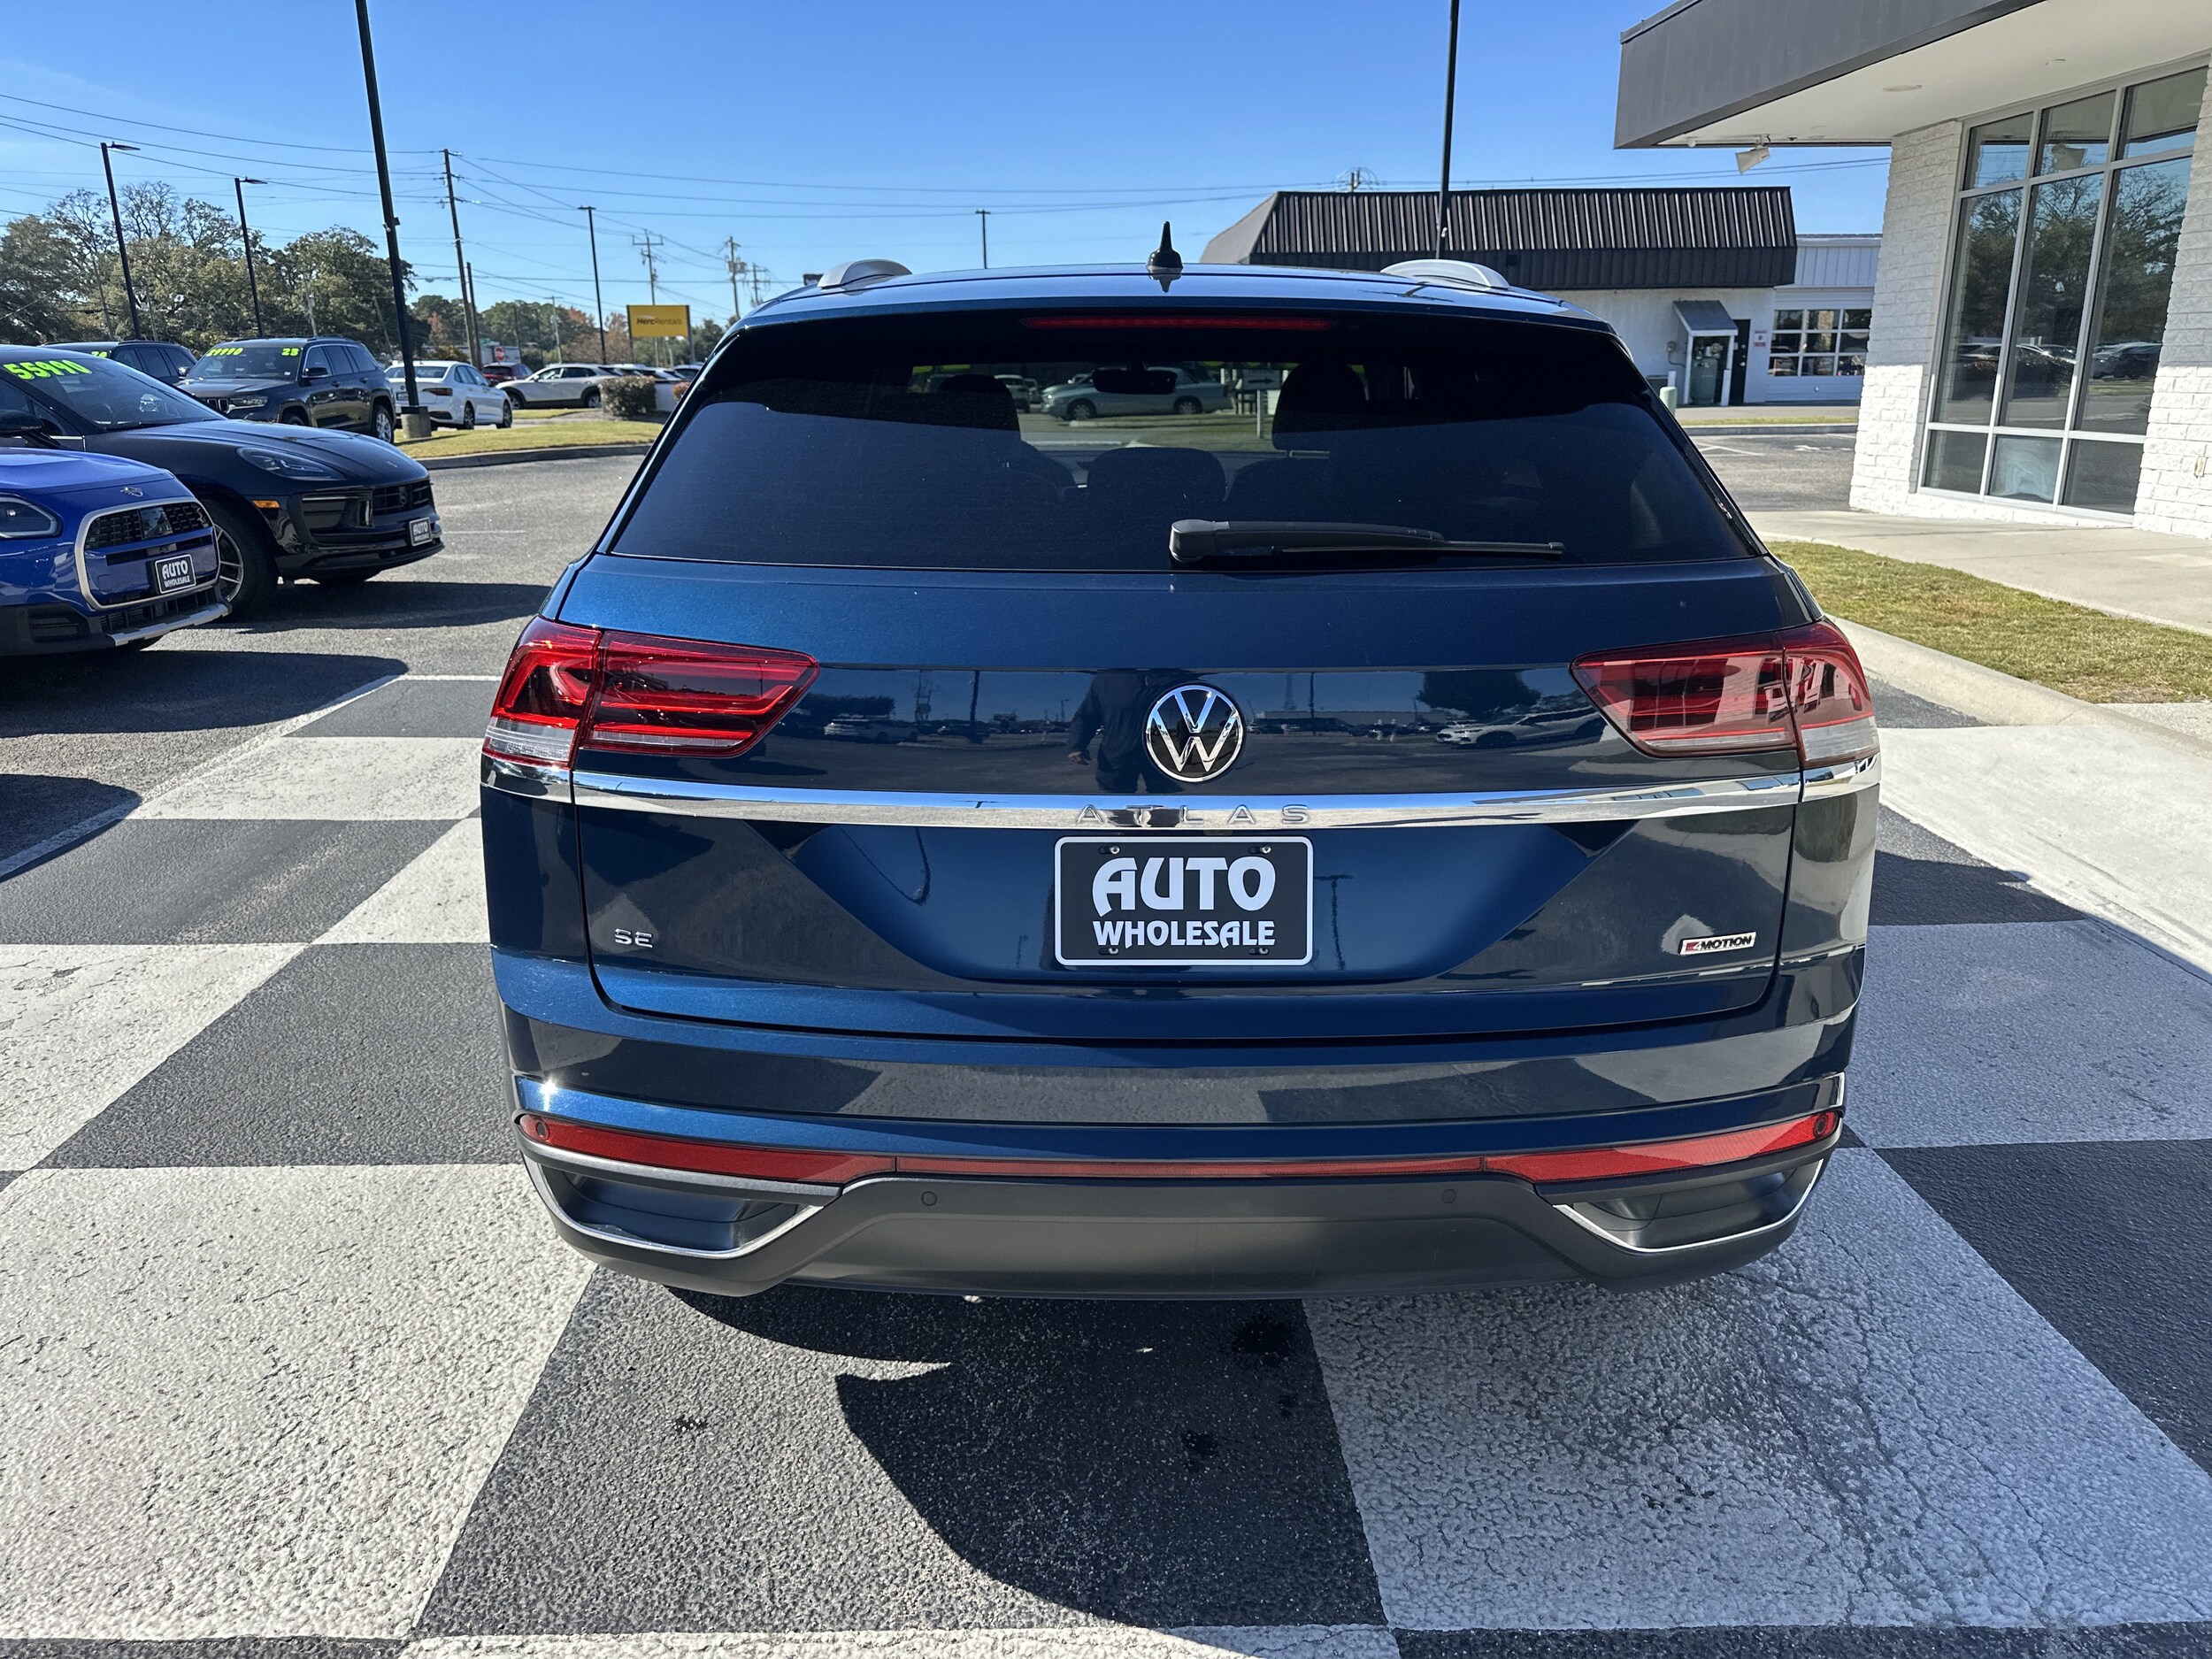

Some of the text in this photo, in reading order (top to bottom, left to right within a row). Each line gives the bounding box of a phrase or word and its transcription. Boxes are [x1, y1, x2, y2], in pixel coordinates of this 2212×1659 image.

[3, 359, 92, 380] 55990
[162, 559, 188, 580] AUTO
[1076, 803, 1309, 825] ATLAS
[1092, 856, 1276, 917] AUTO
[615, 928, 653, 949] SE
[1092, 920, 1276, 949] WHOLESALE
